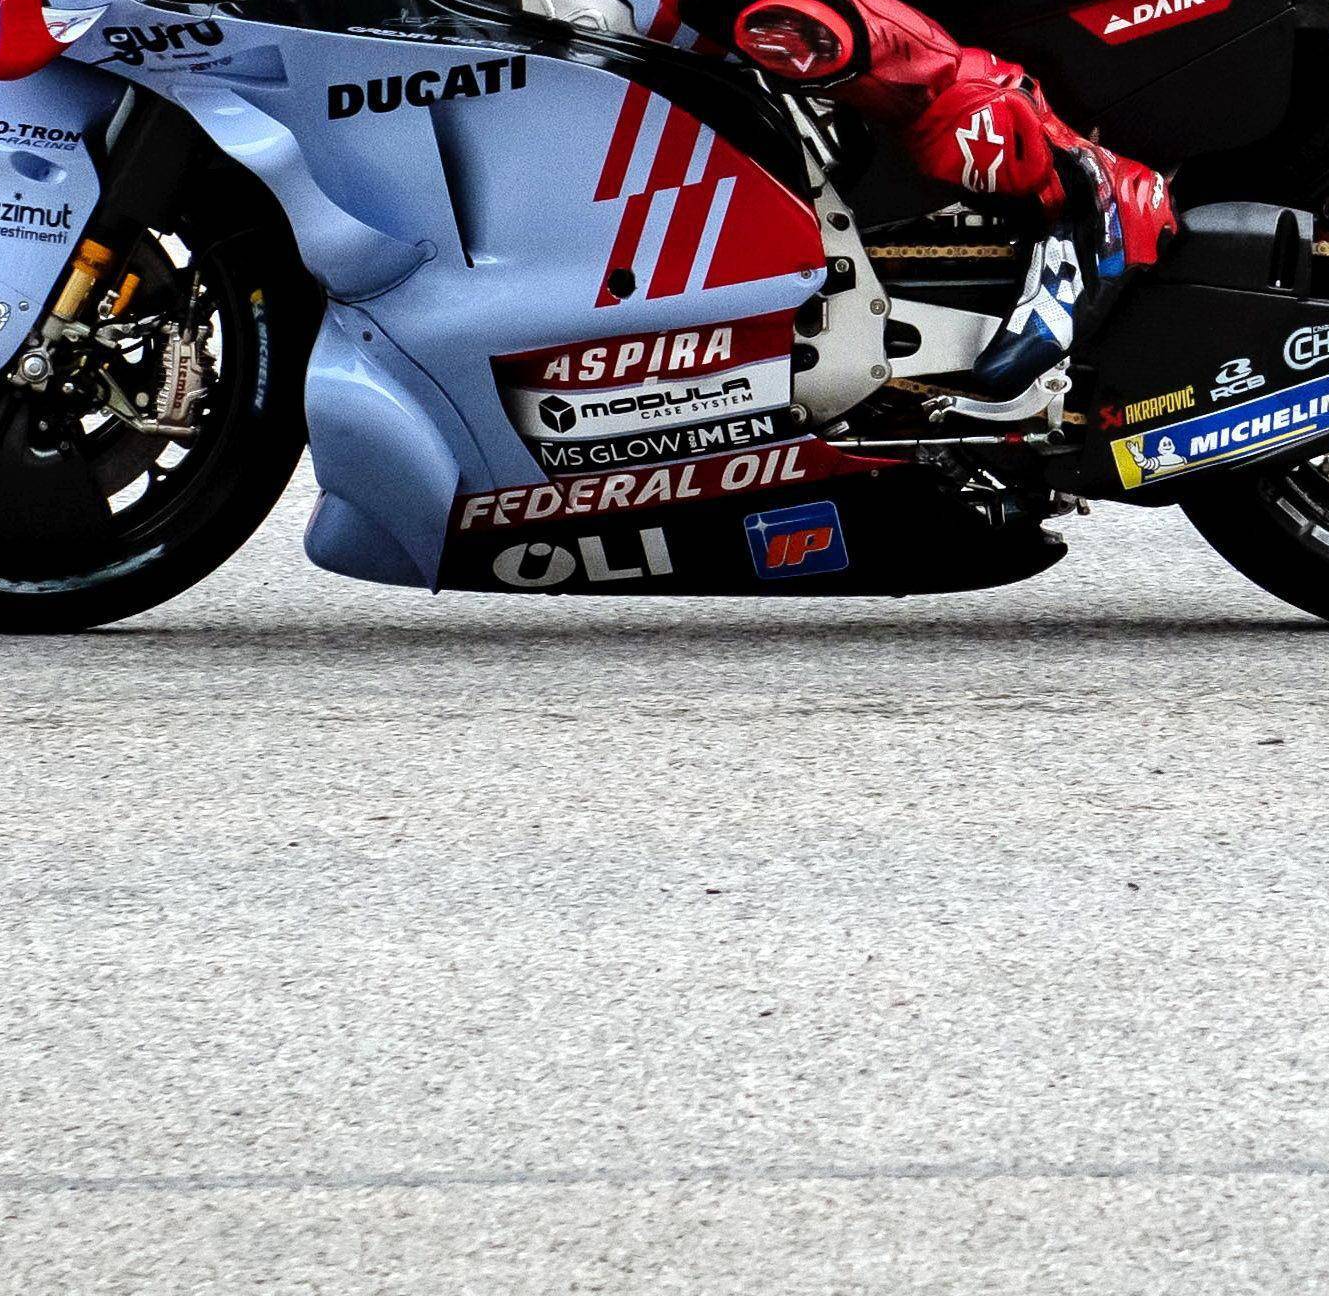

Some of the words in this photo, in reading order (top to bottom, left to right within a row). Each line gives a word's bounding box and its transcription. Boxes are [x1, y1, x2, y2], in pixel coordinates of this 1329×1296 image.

[101, 20, 223, 66] guru
[328, 55, 527, 120] DUCATI
[6, 136, 78, 152] RACING
[543, 327, 733, 384] ASPIRA
[641, 404, 682, 420] CASE
[691, 392, 754, 412] SYSTEM
[1210, 373, 1266, 402] RCB
[541, 445, 583, 467] MS
[589, 432, 681, 464] GLOW
[698, 415, 774, 447] MEN
[459, 465, 701, 531] FEDERAL
[720, 445, 808, 492] OIL
